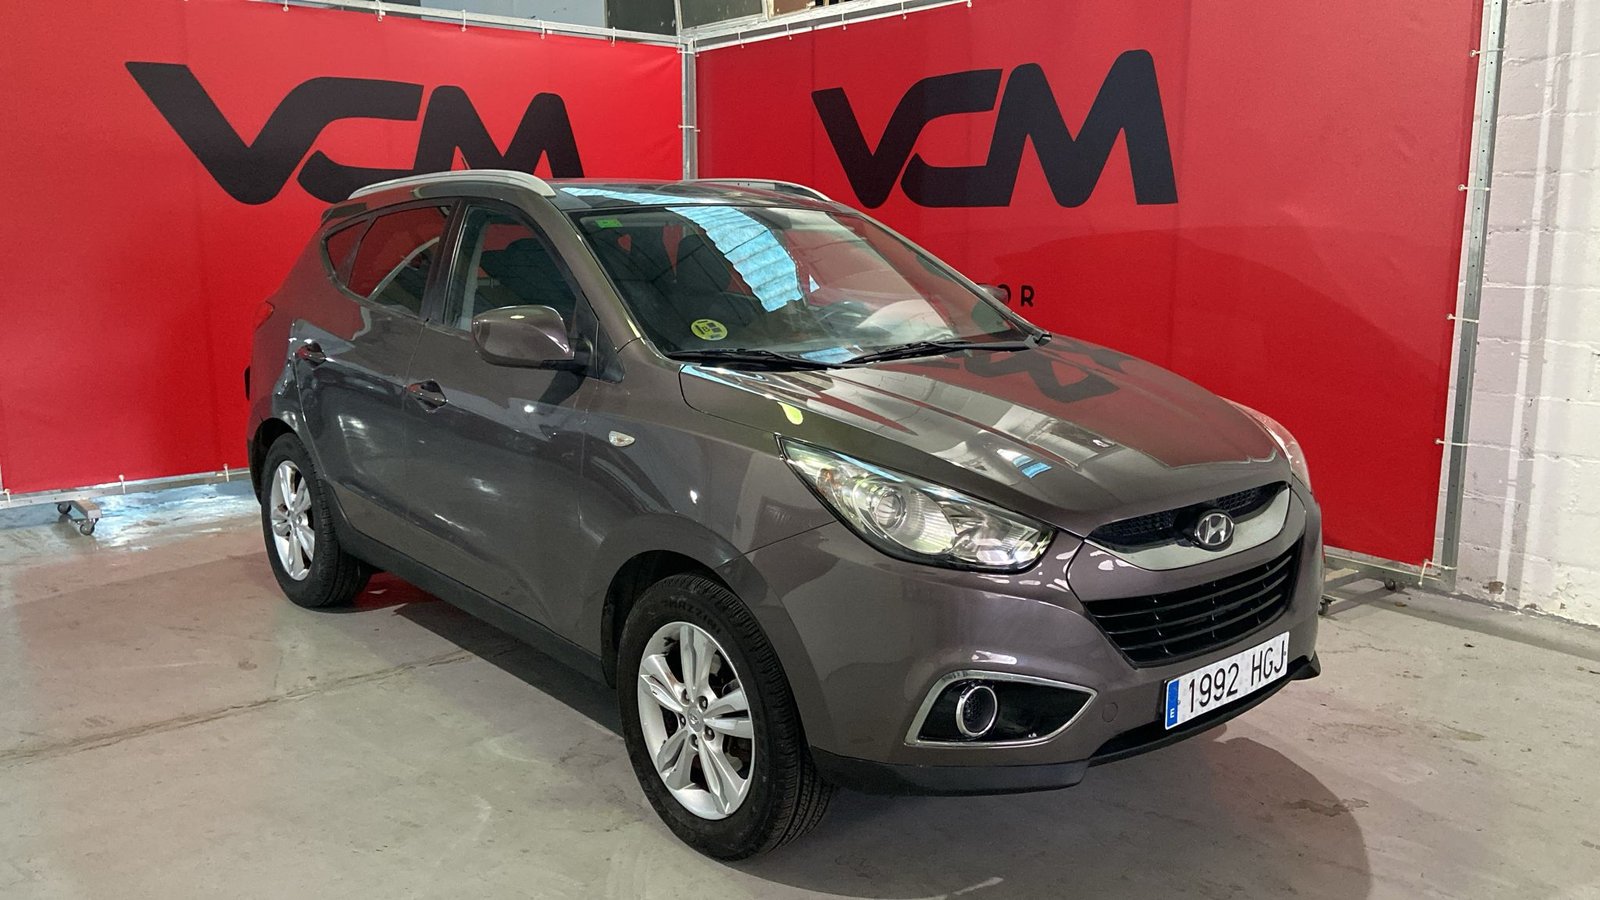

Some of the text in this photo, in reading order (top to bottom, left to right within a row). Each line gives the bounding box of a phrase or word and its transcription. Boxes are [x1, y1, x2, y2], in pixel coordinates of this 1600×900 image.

[125, 61, 584, 205] VCM
[812, 49, 1178, 208] VCM
[1189, 640, 1285, 713] 1992 HGJ
